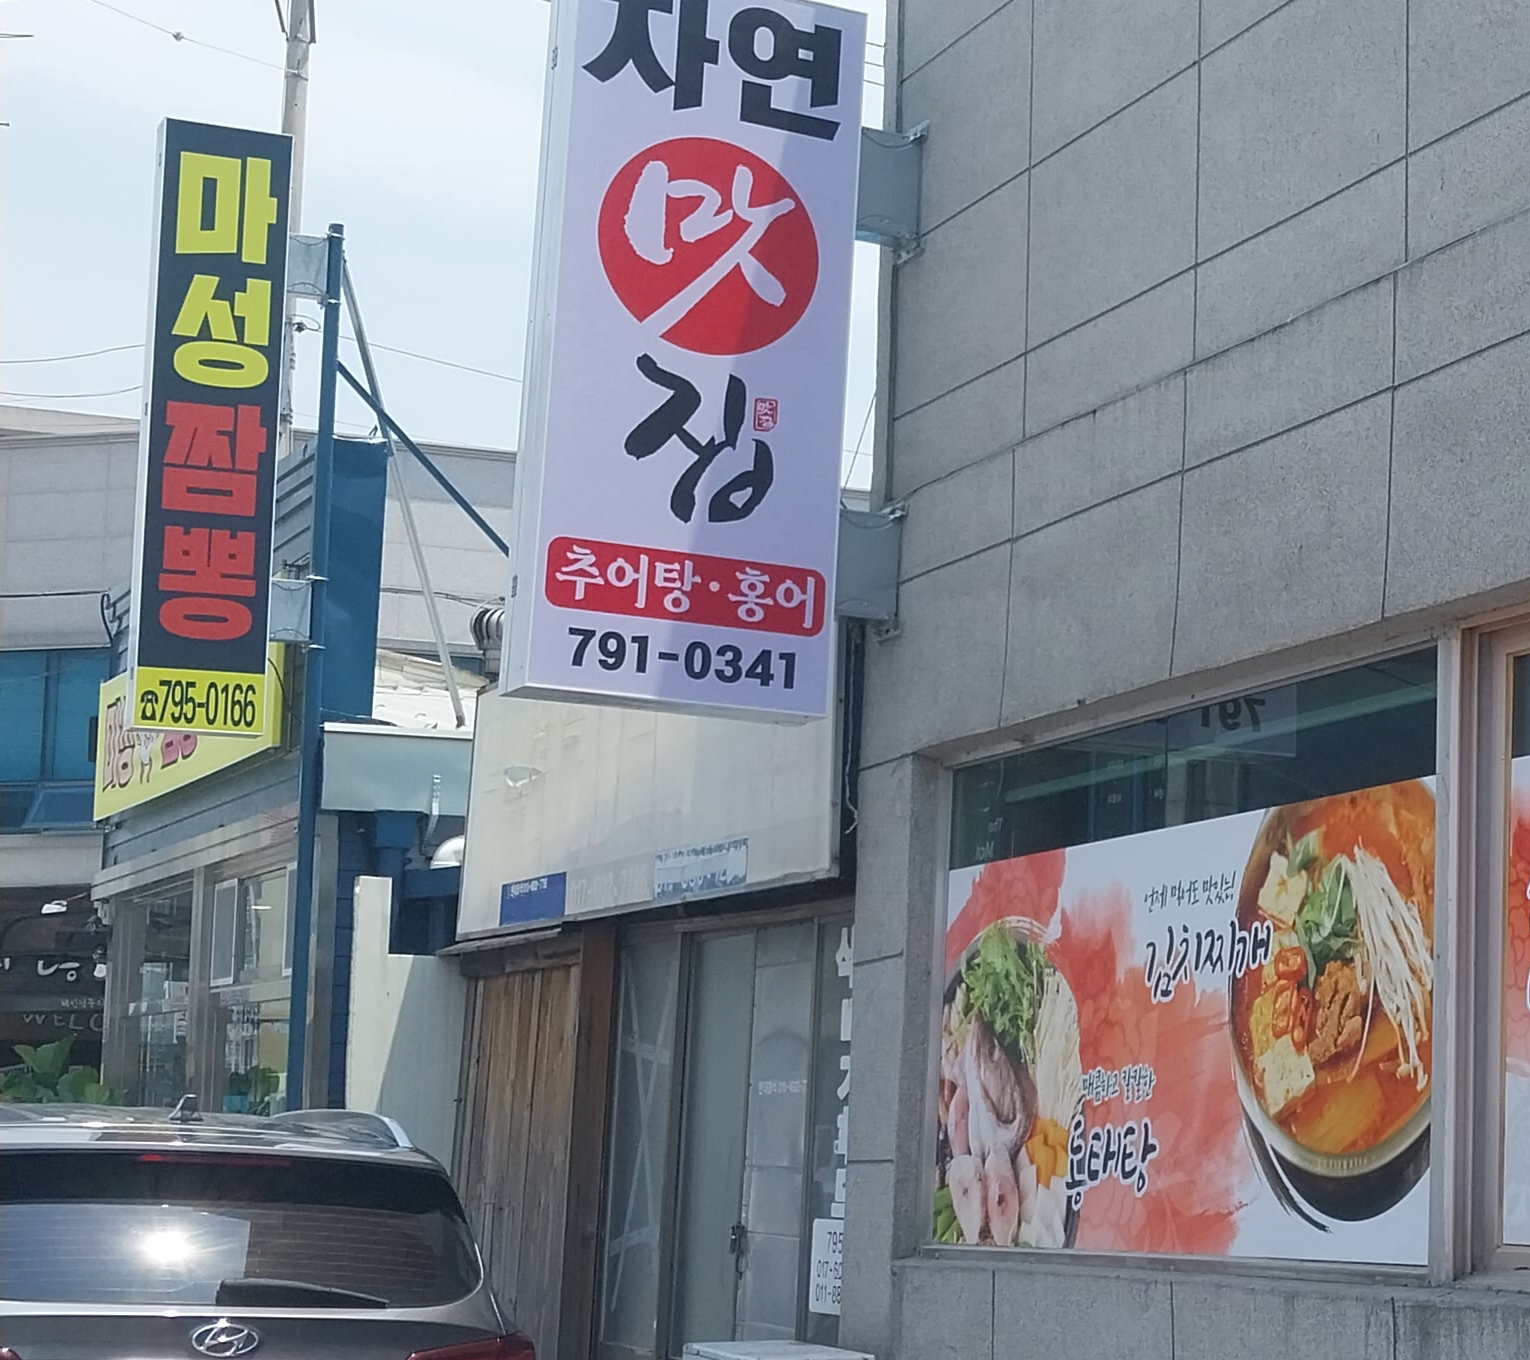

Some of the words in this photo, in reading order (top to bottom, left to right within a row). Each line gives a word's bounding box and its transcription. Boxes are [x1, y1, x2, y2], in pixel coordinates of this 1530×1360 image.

[172, 151, 277, 389] 마성
[159, 400, 267, 641] 짬뽕
[567, 627, 798, 689] 791-0341
[158, 679, 257, 728] 795-0166
[1144, 883, 1168, 913] 언제
[1170, 879, 1200, 907] 먹어도
[1146, 920, 1271, 999] 김치찌개
[1083, 1069, 1118, 1103] 매콤하고
[1065, 1120, 1157, 1206] 동태탕
